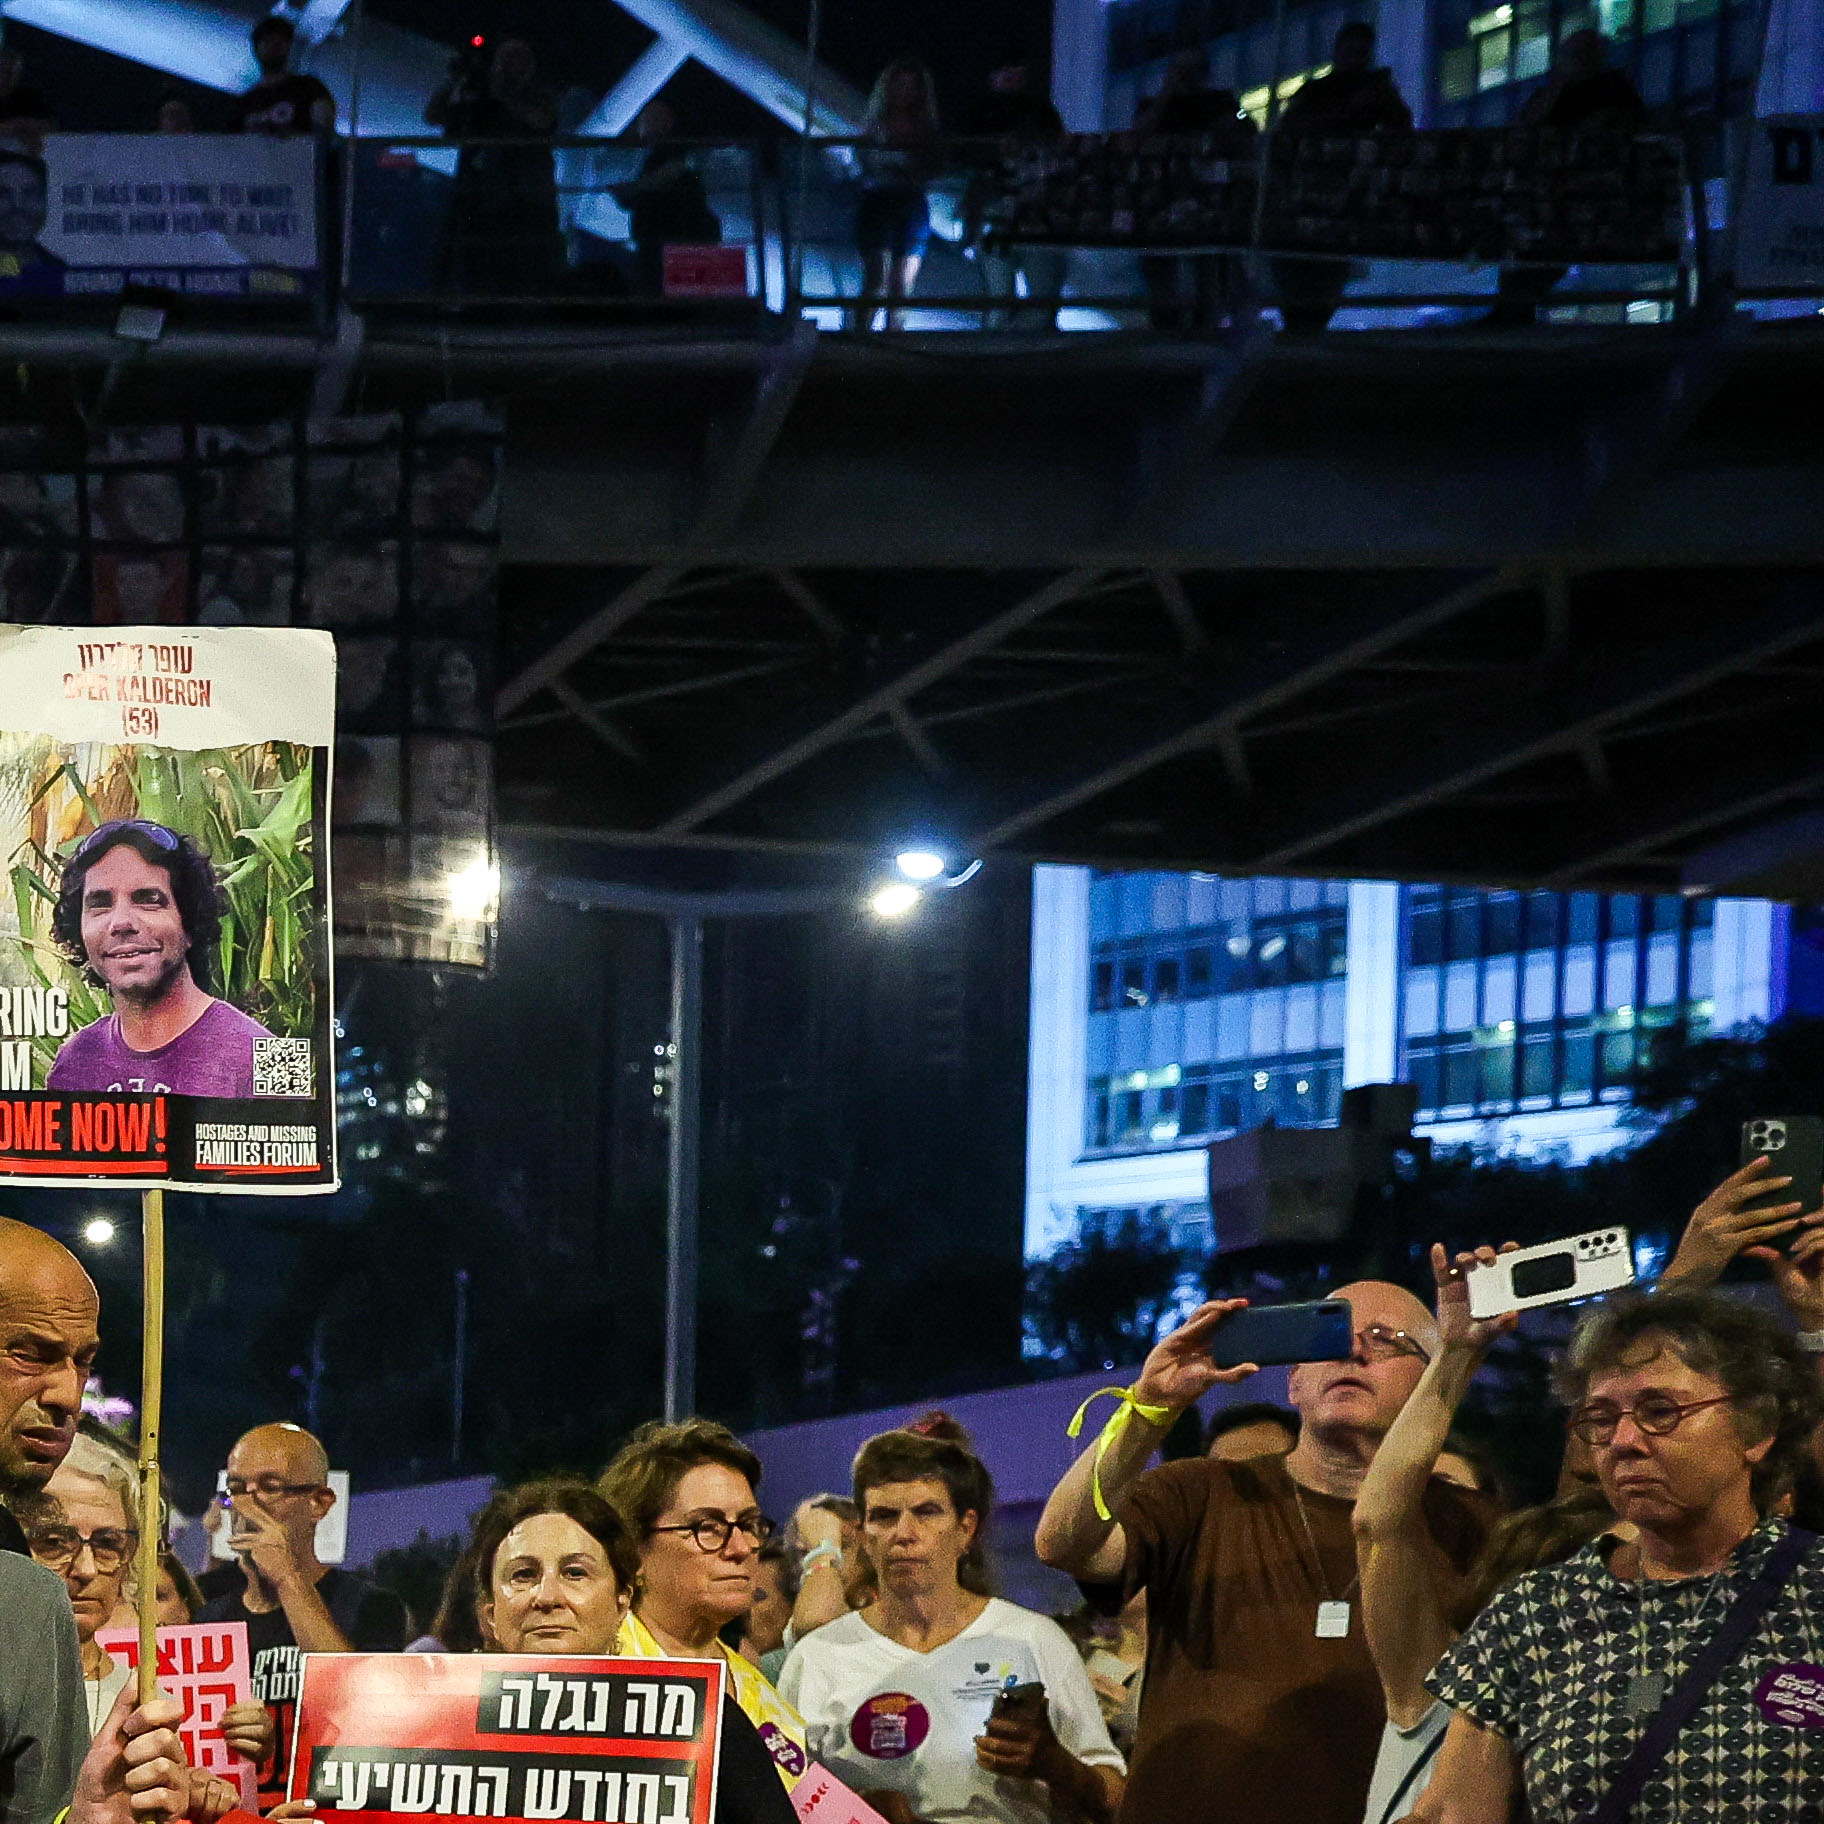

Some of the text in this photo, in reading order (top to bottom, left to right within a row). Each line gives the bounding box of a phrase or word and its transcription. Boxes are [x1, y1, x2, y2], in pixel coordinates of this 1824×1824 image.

[148, 645, 193, 674] עופר
[116, 674, 212, 708] KALDERON
[121, 705, 159, 739] (53)
[71, 1096, 169, 1153] NOW!
[195, 1123, 317, 1143] HOSTAGES AND MISSING
[195, 1141, 318, 1168] FAMILIES FORUM
[498, 1673, 696, 1736] מה נגלה
[322, 1759, 510, 1818] התשיעי
